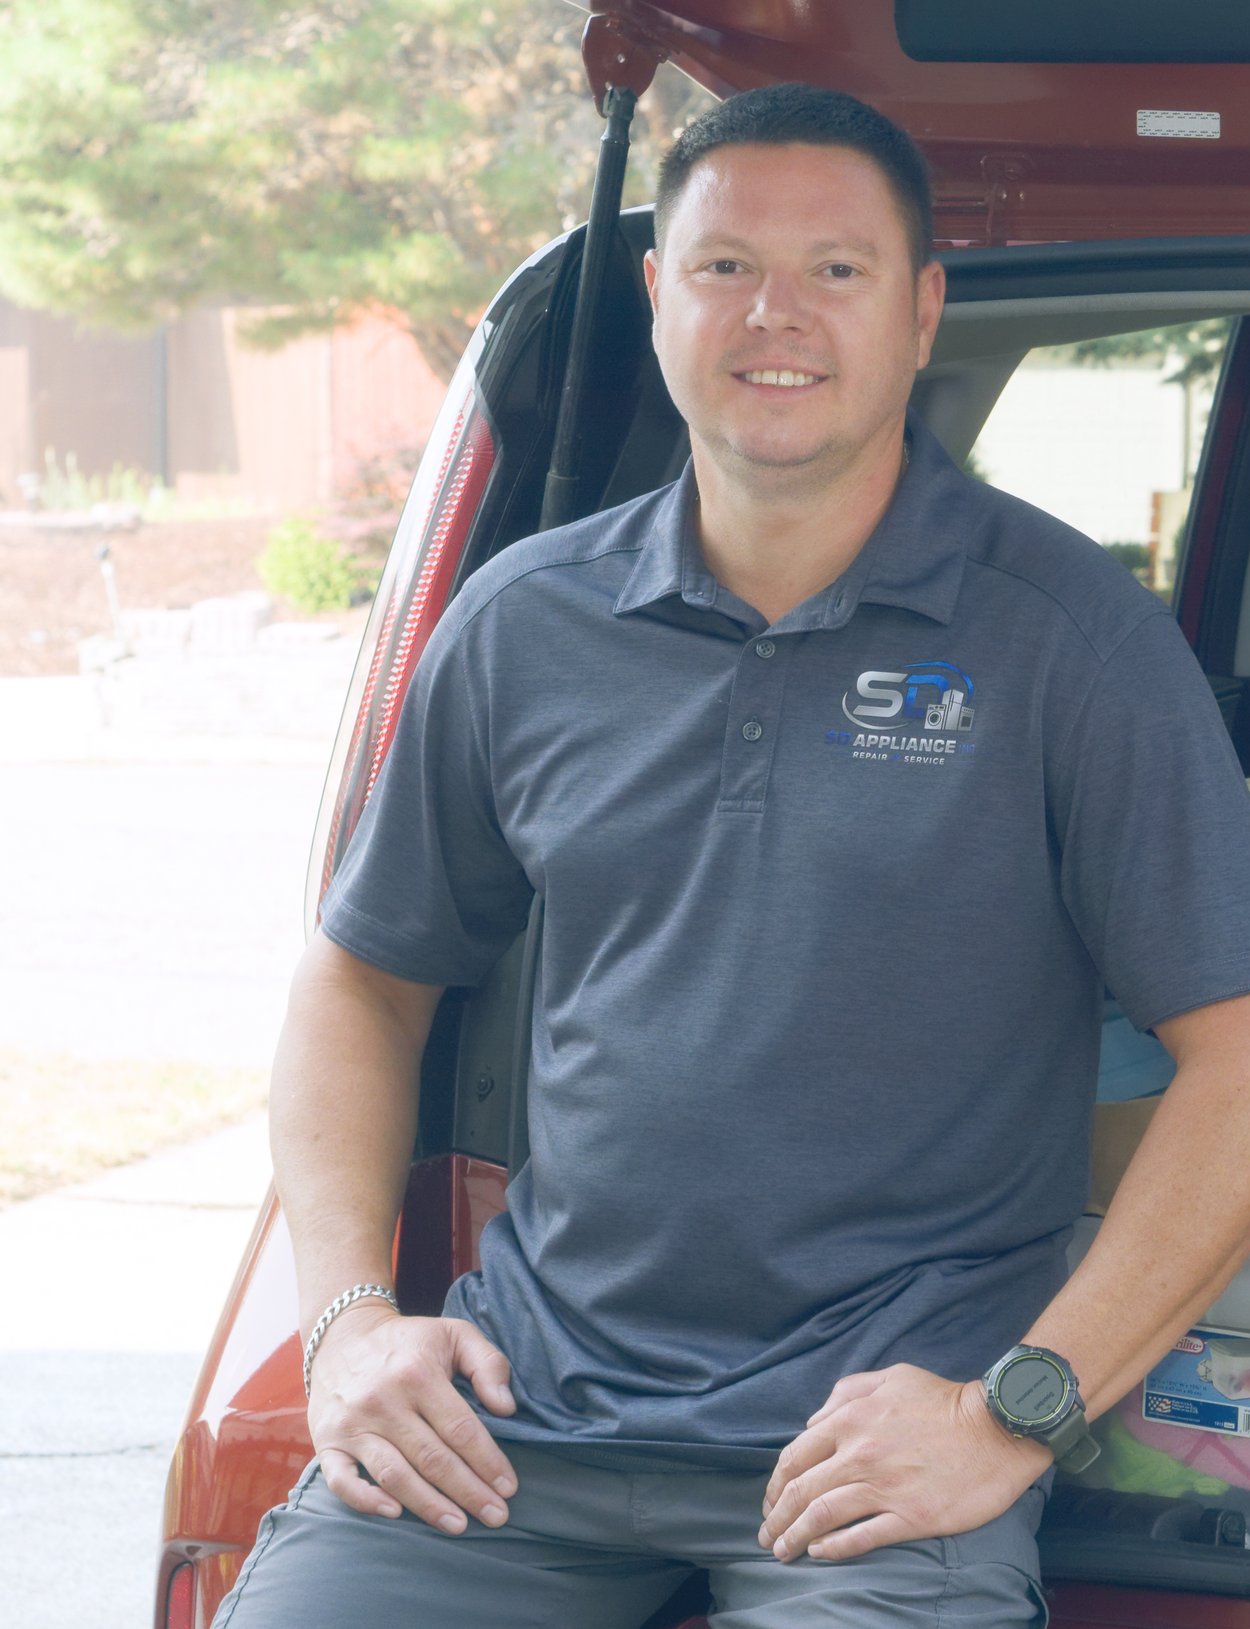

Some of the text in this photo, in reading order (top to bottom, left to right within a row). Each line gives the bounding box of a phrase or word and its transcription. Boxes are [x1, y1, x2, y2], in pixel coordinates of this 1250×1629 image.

[853, 734, 957, 753] APPLIANCE
[853, 751, 888, 761] REPAIR
[904, 755, 945, 766] SERVICE
[1175, 1337, 1200, 1351] rilite
